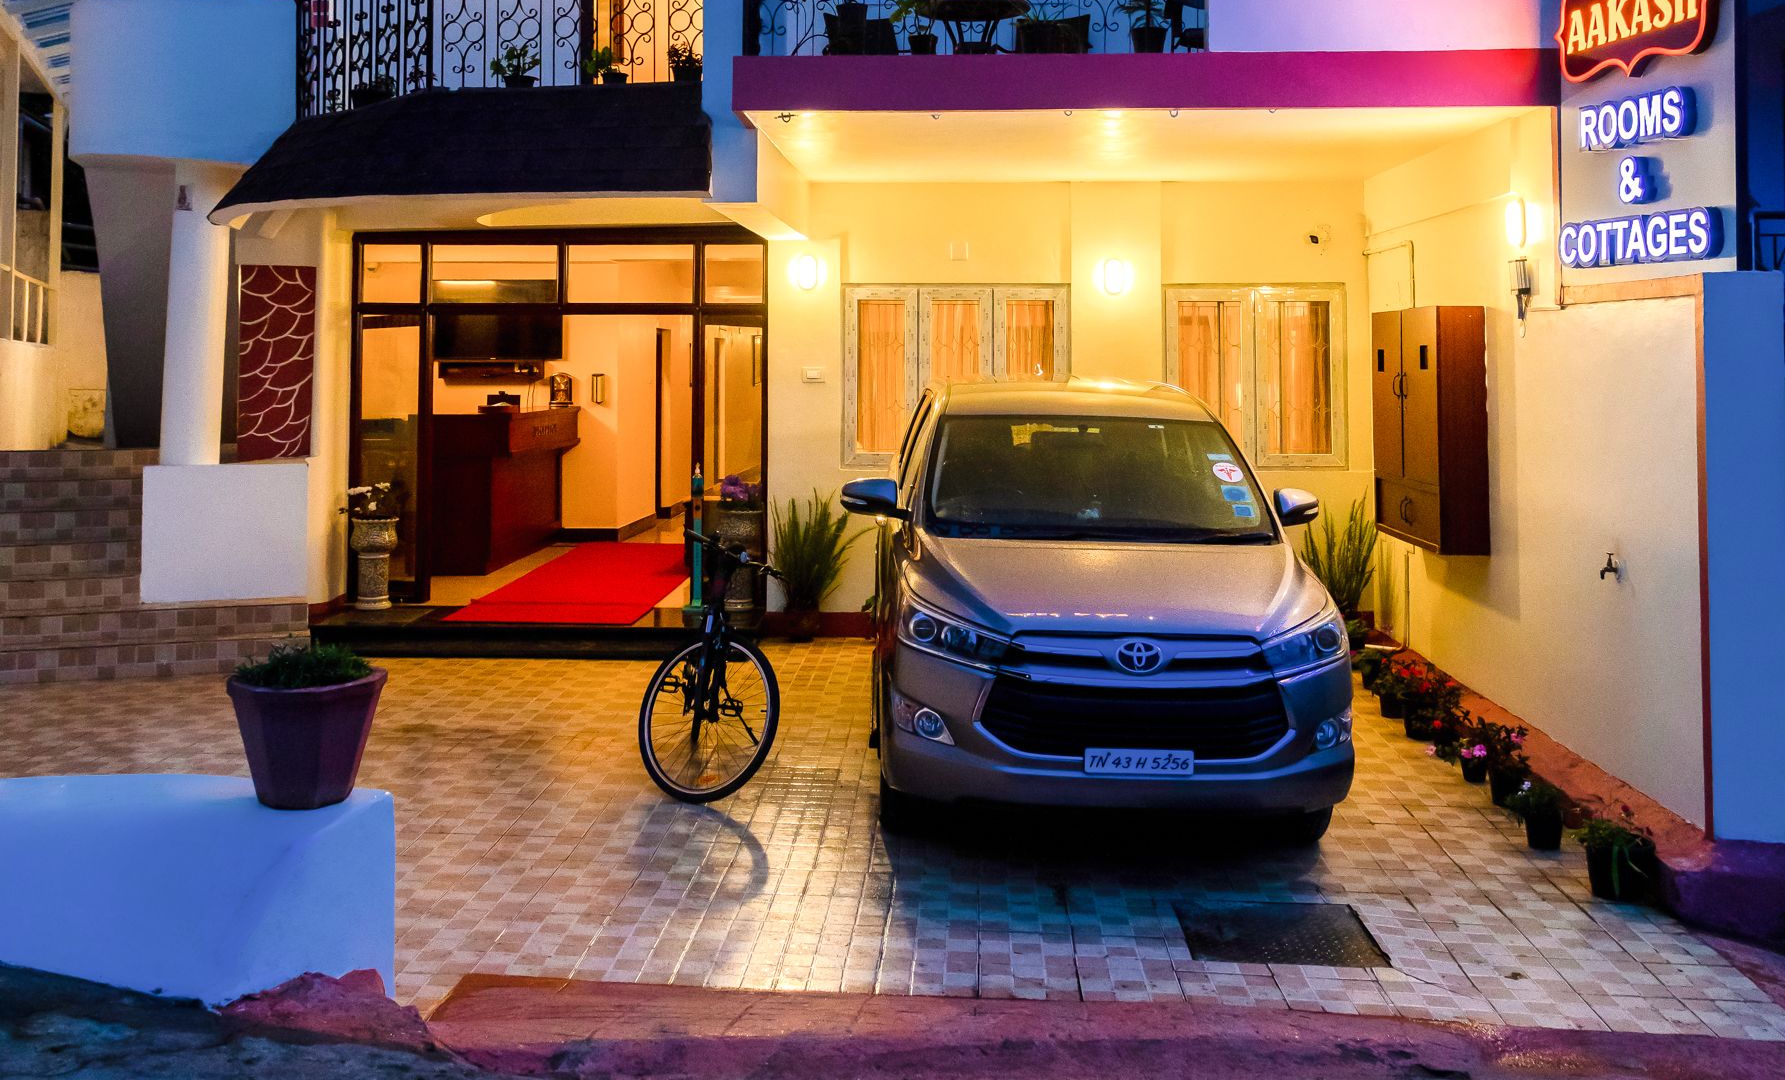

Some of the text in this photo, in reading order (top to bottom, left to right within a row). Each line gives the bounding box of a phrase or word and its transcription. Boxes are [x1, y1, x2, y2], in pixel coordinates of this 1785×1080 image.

[1579, 89, 1684, 149] ROOMS
[1618, 157, 1643, 204] &
[1559, 210, 1709, 265] COTTAGES
[1089, 754, 1190, 770] TN 43 H 5256
